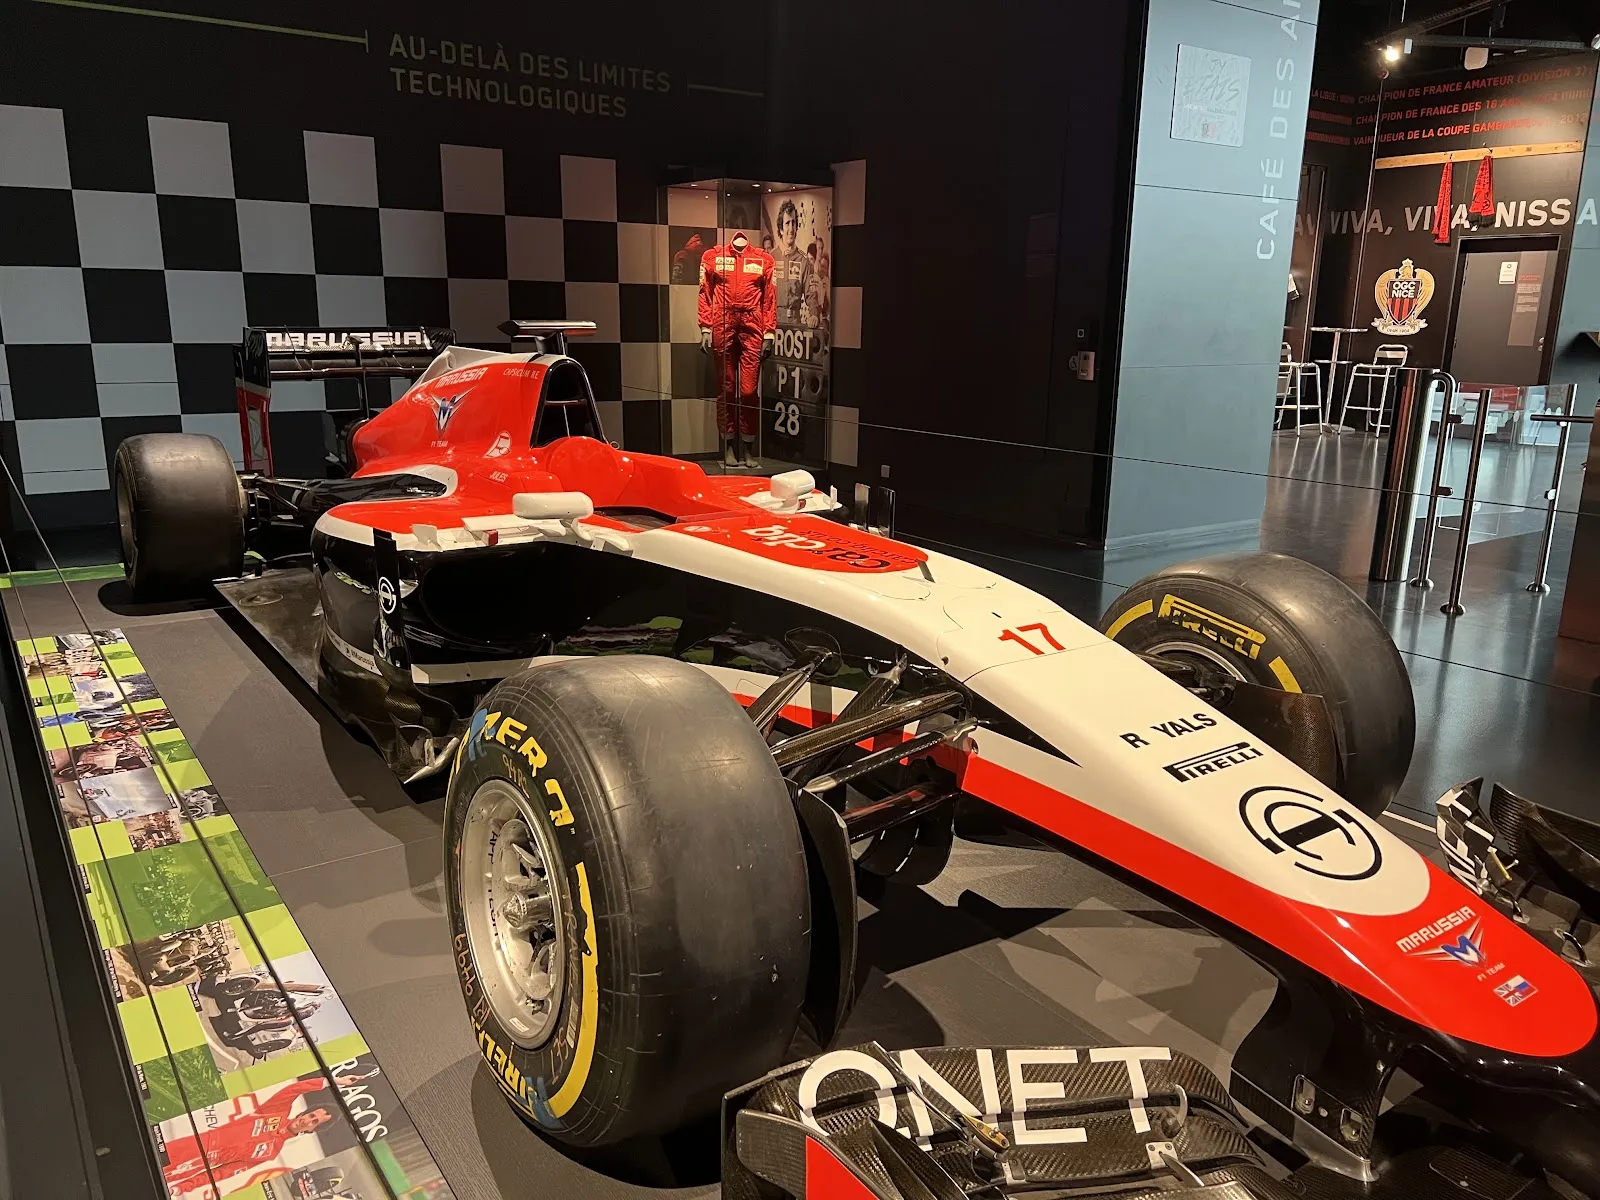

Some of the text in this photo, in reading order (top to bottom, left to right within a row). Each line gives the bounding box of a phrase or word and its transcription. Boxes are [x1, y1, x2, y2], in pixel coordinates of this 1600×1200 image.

[389, 33, 670, 92] AU-DELÀ DES LIMITES
[390, 67, 627, 118] TECHNOLOGIQUES
[1269, 57, 1296, 140] DES
[1408, 88, 1421, 97] DE
[1423, 82, 1463, 96] FRANCE
[1464, 75, 1514, 91] AMATEUR
[1405, 109, 1418, 119] DE
[1420, 103, 1460, 117] FRANCE
[1461, 102, 1482, 113] DES
[1353, 132, 1405, 146] VAINUEUR
[1407, 129, 1420, 140] DE
[1421, 128, 1435, 139] LA
[1437, 124, 1471, 137] COUPE
[1257, 157, 1285, 260] CAFÉ
[1330, 208, 1394, 236] VIVA,
[1404, 203, 1479, 232] VIA,
[1391, 289, 1415, 298] NICE
[1392, 281, 1416, 290] OGC
[774, 329, 814, 361] ROST
[434, 366, 489, 389] MARUSSIA
[774, 401, 800, 437] 28
[489, 470, 508, 483] JULES
[997, 622, 1067, 656] 17
[1162, 741, 1264, 783] PIRELLI
[1396, 905, 1477, 953] MARUSSIA
[1477, 962, 1506, 982] F1 TEAM
[798, 1046, 1172, 1151] ONET
